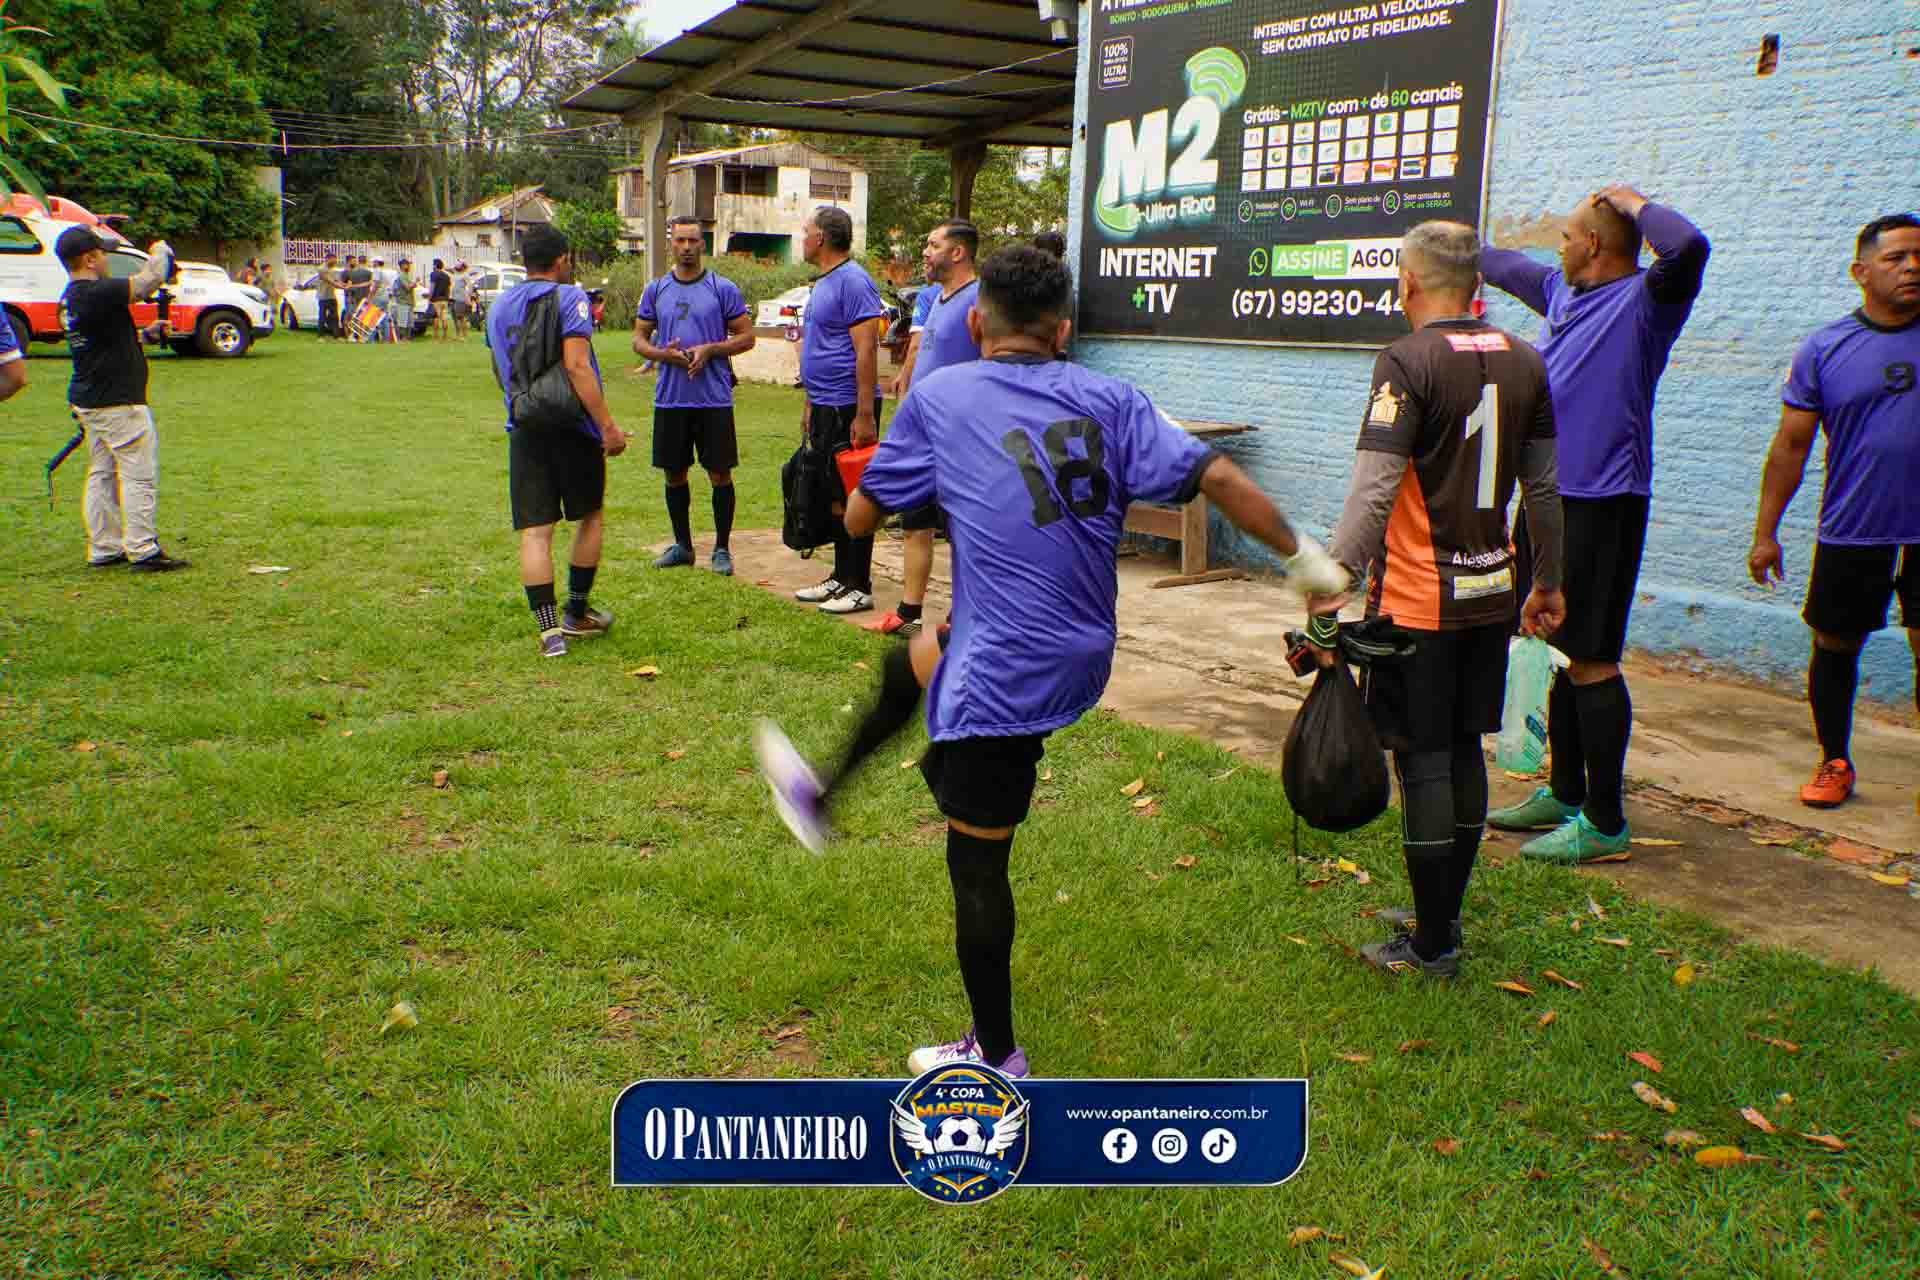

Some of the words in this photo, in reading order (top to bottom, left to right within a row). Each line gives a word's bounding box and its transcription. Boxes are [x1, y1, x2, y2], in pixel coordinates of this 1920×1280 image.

[1253, 18, 1308, 39] INTERNET
[1310, 12, 1336, 30] COM
[1339, 8, 1377, 25] ULTRA
[1262, 40, 1285, 54] SEM
[1287, 30, 1350, 50] CONTRATO
[1352, 26, 1370, 40] DE
[1372, 10, 1452, 37] FIDELIDADE.
[1104, 42, 1129, 57] 100%
[1290, 99, 1328, 120] M2TV
[1328, 99, 1359, 115] com
[1370, 91, 1388, 110] de
[1390, 90, 1408, 106] 60
[1410, 82, 1463, 105] canais
[1103, 96, 1221, 207] M2
[1100, 247, 1217, 277] INTERNET
[1277, 249, 1343, 271] ASSINE
[1232, 288, 1275, 319] (67)
[1465, 383, 1498, 510] 1
[1003, 419, 1109, 528] 18
